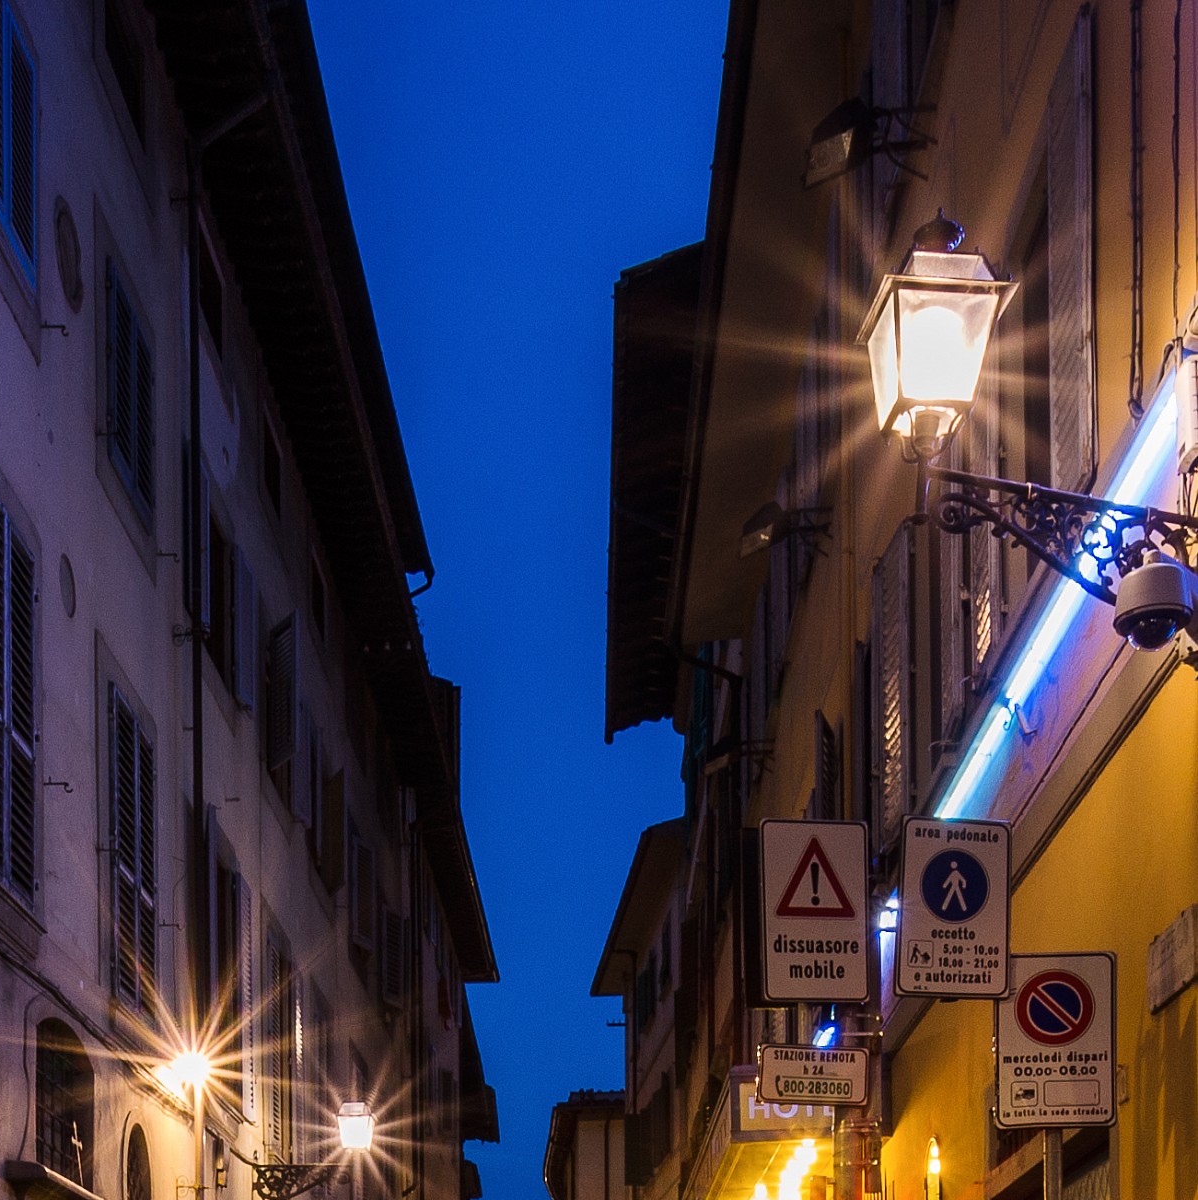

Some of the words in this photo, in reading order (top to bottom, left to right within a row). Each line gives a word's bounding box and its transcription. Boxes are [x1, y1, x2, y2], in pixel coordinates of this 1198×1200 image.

[915, 826, 941, 839] area
[947, 828, 999, 843] pedonale
[931, 927, 976, 941] eccetto
[773, 934, 860, 955] dissuasore
[789, 960, 846, 980] mobile
[914, 973, 921, 982] e
[925, 971, 992, 984] autorizzati
[773, 1050, 817, 1062] STAZIONE
[819, 1052, 856, 1064] REMOTA
[1066, 1050, 1108, 1063] dispari
[812, 1066, 825, 1076] 24
